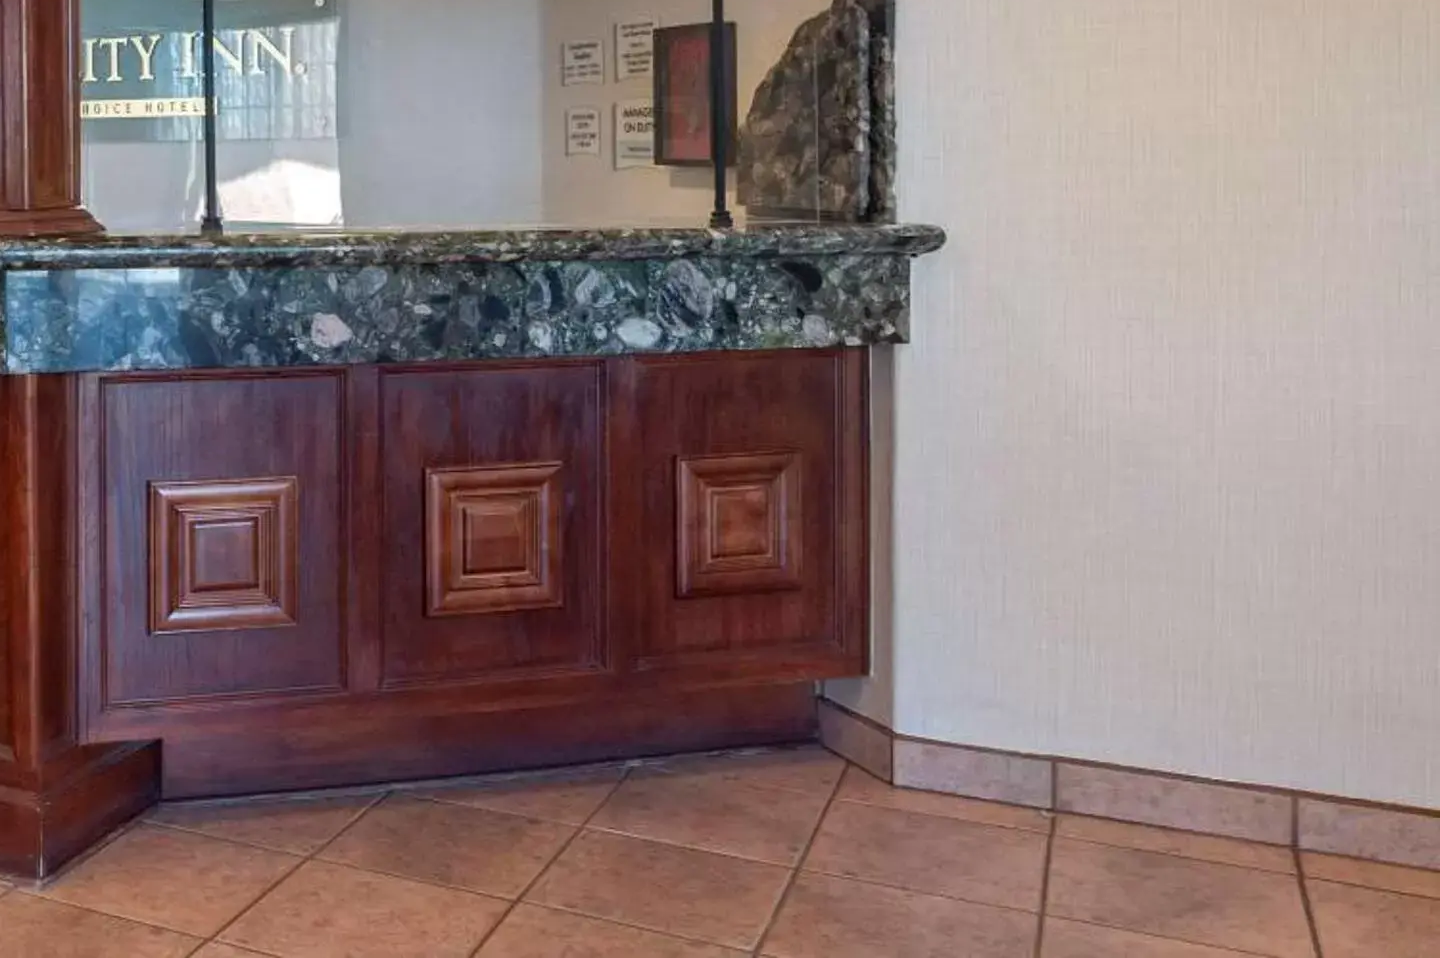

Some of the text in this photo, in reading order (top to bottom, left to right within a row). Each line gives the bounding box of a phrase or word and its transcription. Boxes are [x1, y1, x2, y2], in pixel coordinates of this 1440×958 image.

[81, 100, 202, 116] HOICE HOTEL
[622, 105, 654, 119] MANAGE
